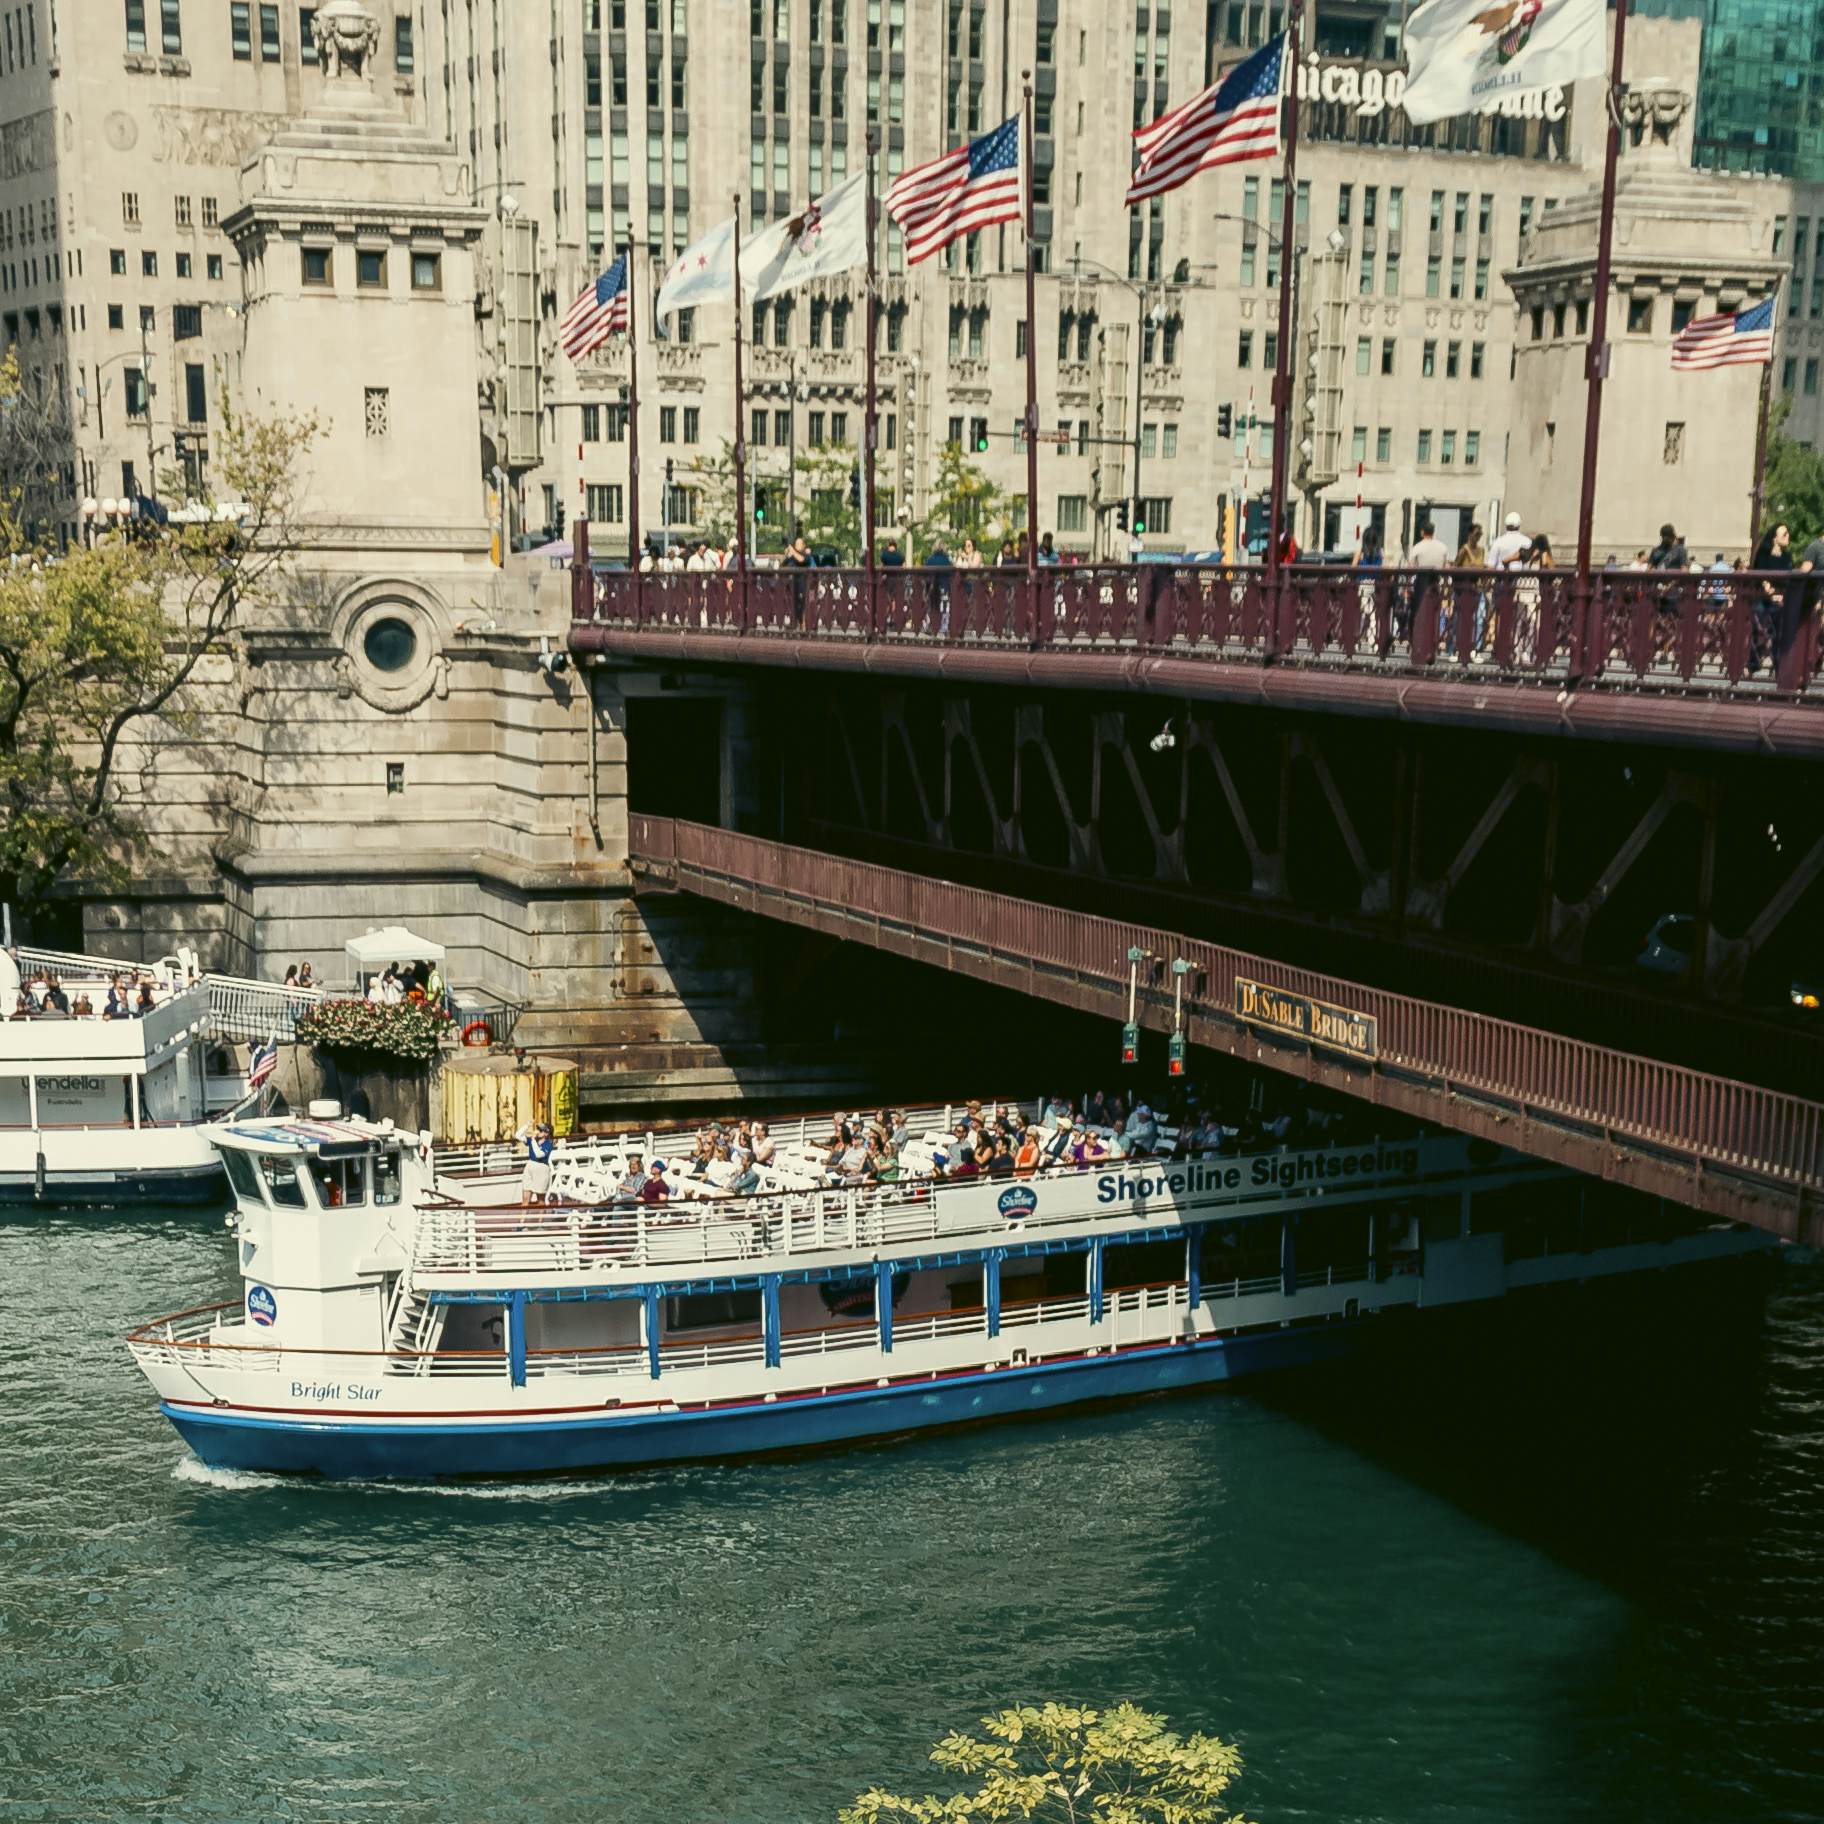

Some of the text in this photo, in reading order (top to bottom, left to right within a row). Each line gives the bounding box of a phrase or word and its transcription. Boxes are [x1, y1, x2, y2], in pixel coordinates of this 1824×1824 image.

[1285, 48, 1407, 116] hicago
[1096, 1149, 1420, 1204] Shoreline Sightseeing
[290, 1381, 382, 1402] Bright Star
